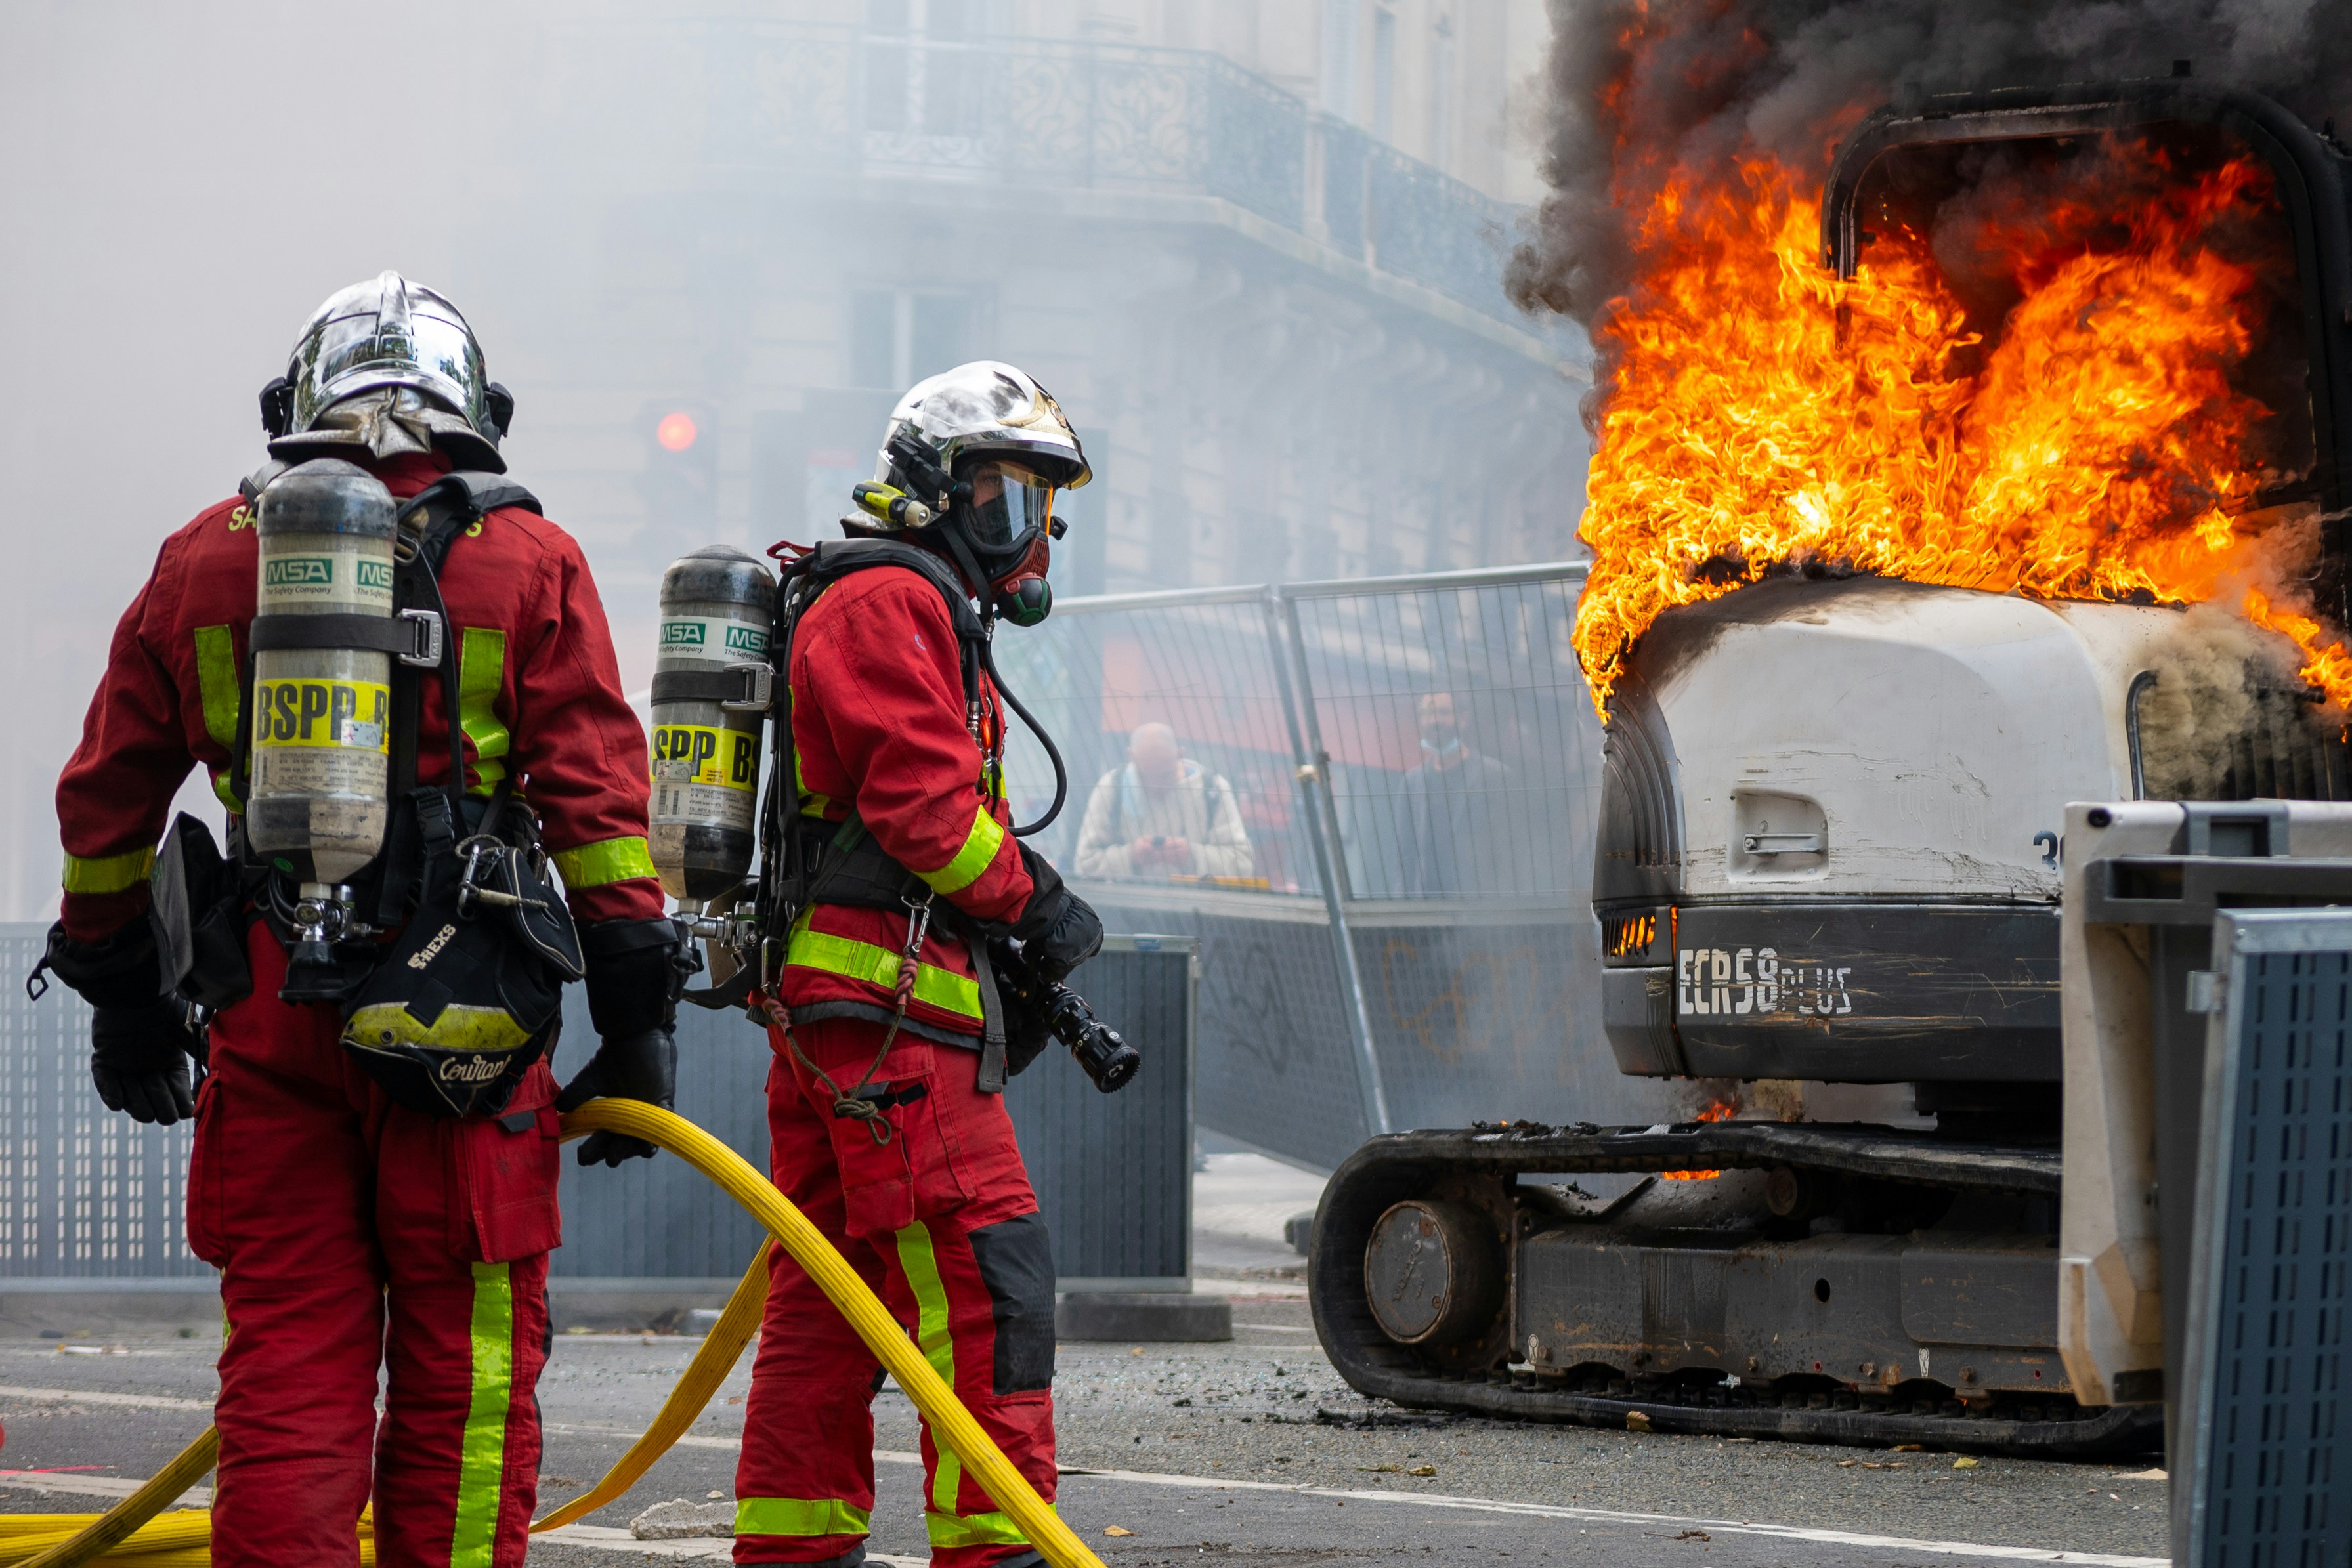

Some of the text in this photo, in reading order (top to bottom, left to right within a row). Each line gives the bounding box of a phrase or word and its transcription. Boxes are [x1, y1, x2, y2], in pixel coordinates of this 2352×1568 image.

[267, 561, 329, 583] MSA
[360, 564, 393, 587] MS
[295, 585, 331, 595] Company
[660, 625, 702, 642] MSA
[675, 645, 704, 654] Company
[736, 650, 754, 660] Safety
[257, 683, 356, 741] BSPP
[649, 729, 716, 777] SPP
[2033, 830, 2065, 872] 3
[1679, 948, 1778, 1015] ECR58
[440, 1054, 512, 1081] Courant
